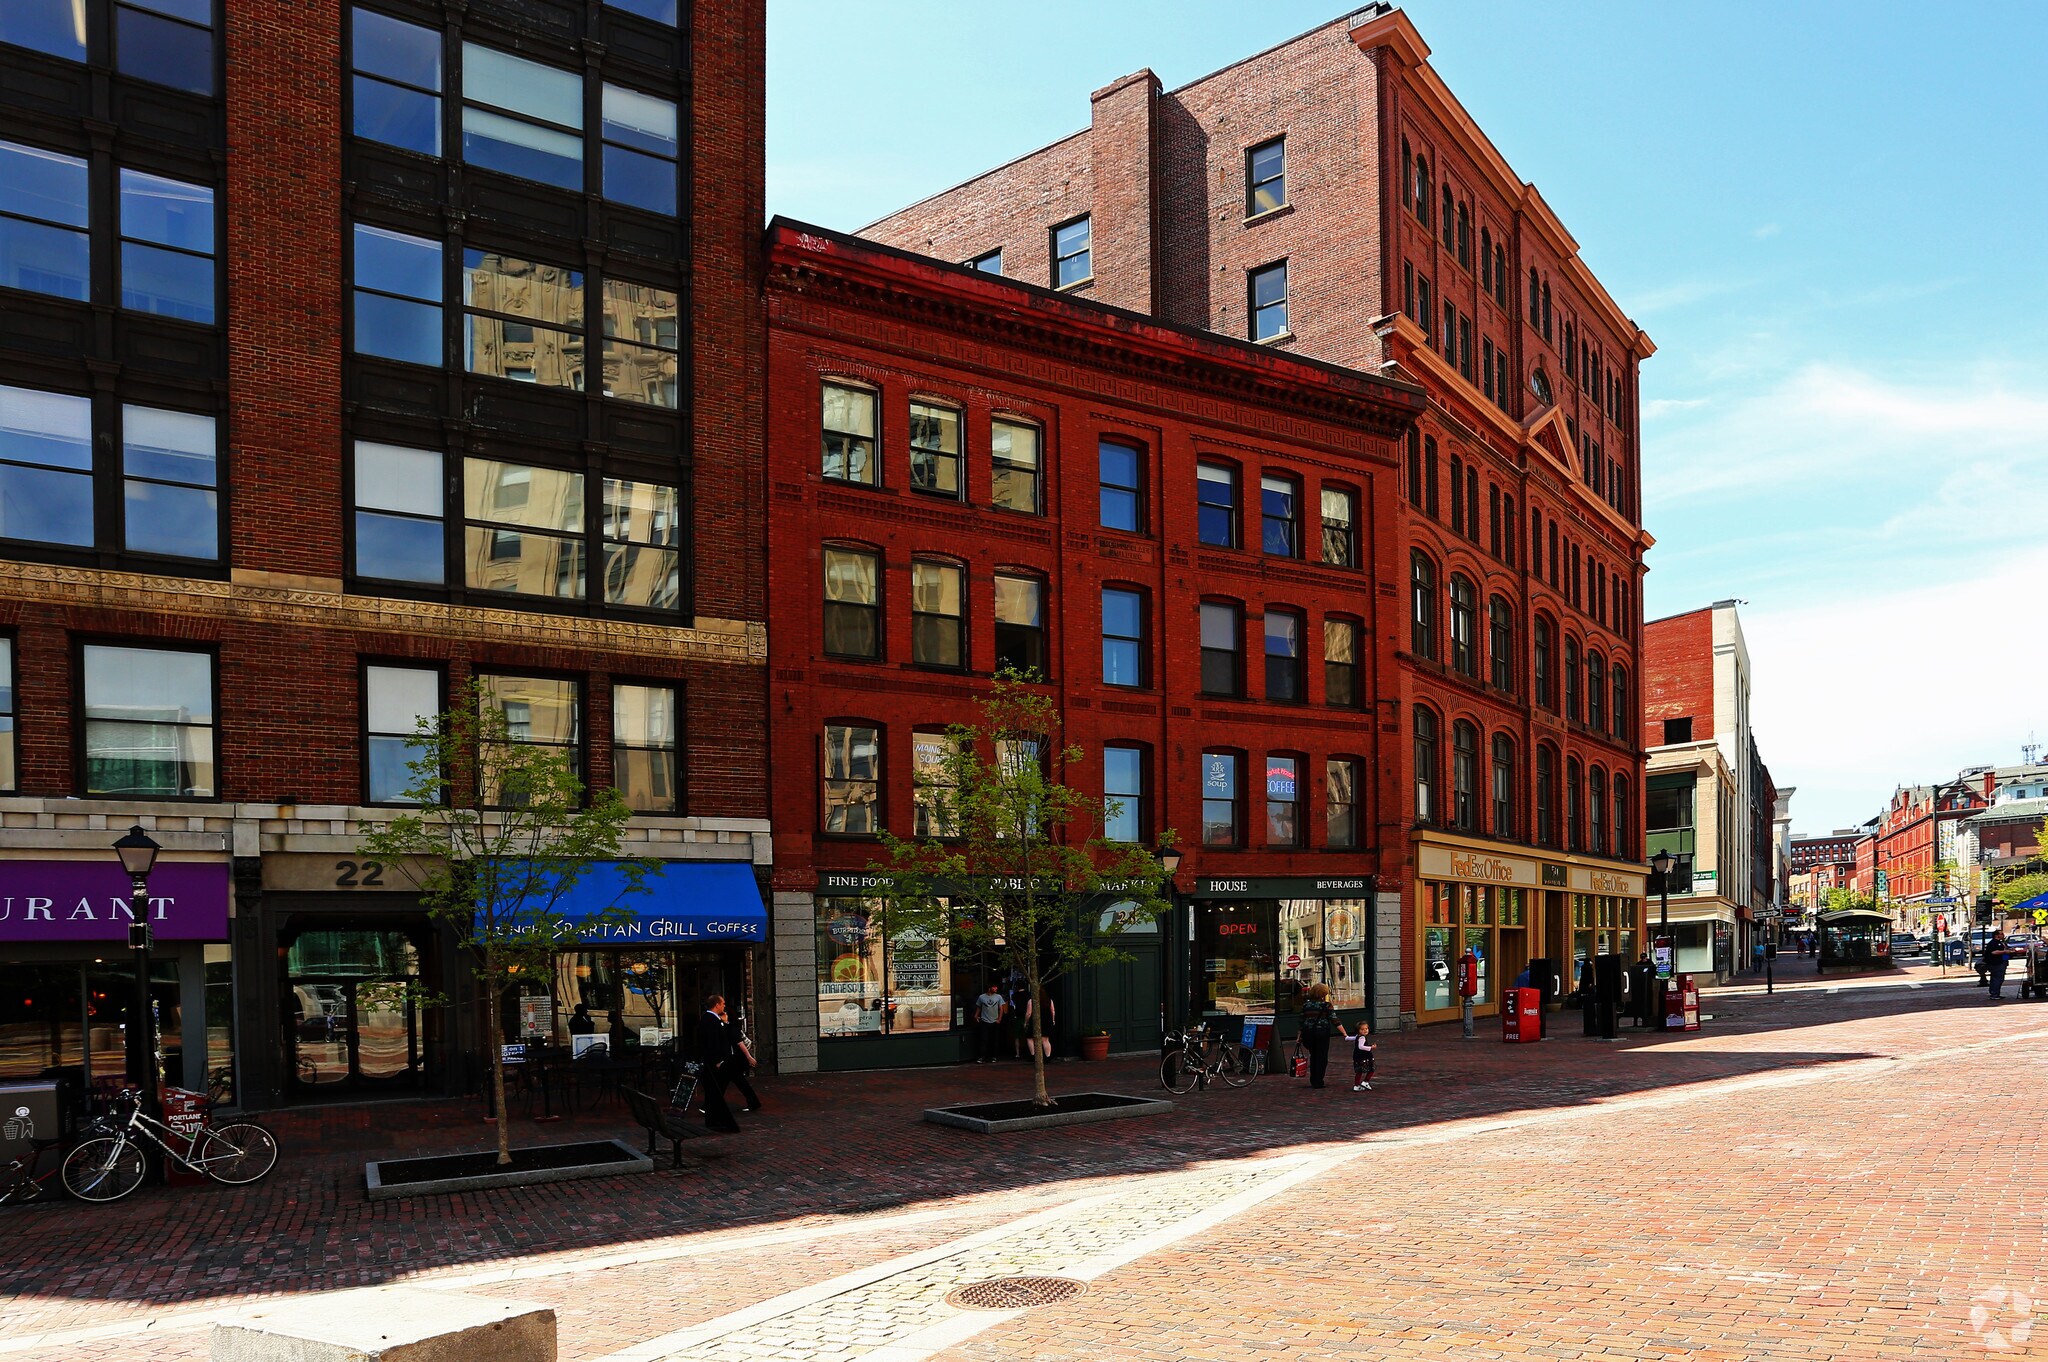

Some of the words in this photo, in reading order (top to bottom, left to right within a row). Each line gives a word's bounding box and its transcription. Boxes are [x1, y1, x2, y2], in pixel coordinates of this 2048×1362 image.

[1207, 780, 1228, 792] soup
[1451, 851, 1484, 878] FedEx
[1484, 854, 1512, 882] Office
[336, 861, 384, 886] 22
[828, 876, 858, 887] FINE
[862, 877, 894, 888] FOOD
[989, 878, 1040, 890] PUBLC
[1100, 879, 1154, 891] MARK
[1210, 881, 1248, 892] HOUSE
[1317, 880, 1364, 889] BEVERAGES
[649, 917, 698, 937] GRILL
[707, 921, 757, 934] COFFEE
[1219, 923, 1257, 936] OPEN
[822, 984, 846, 994] MAINE
